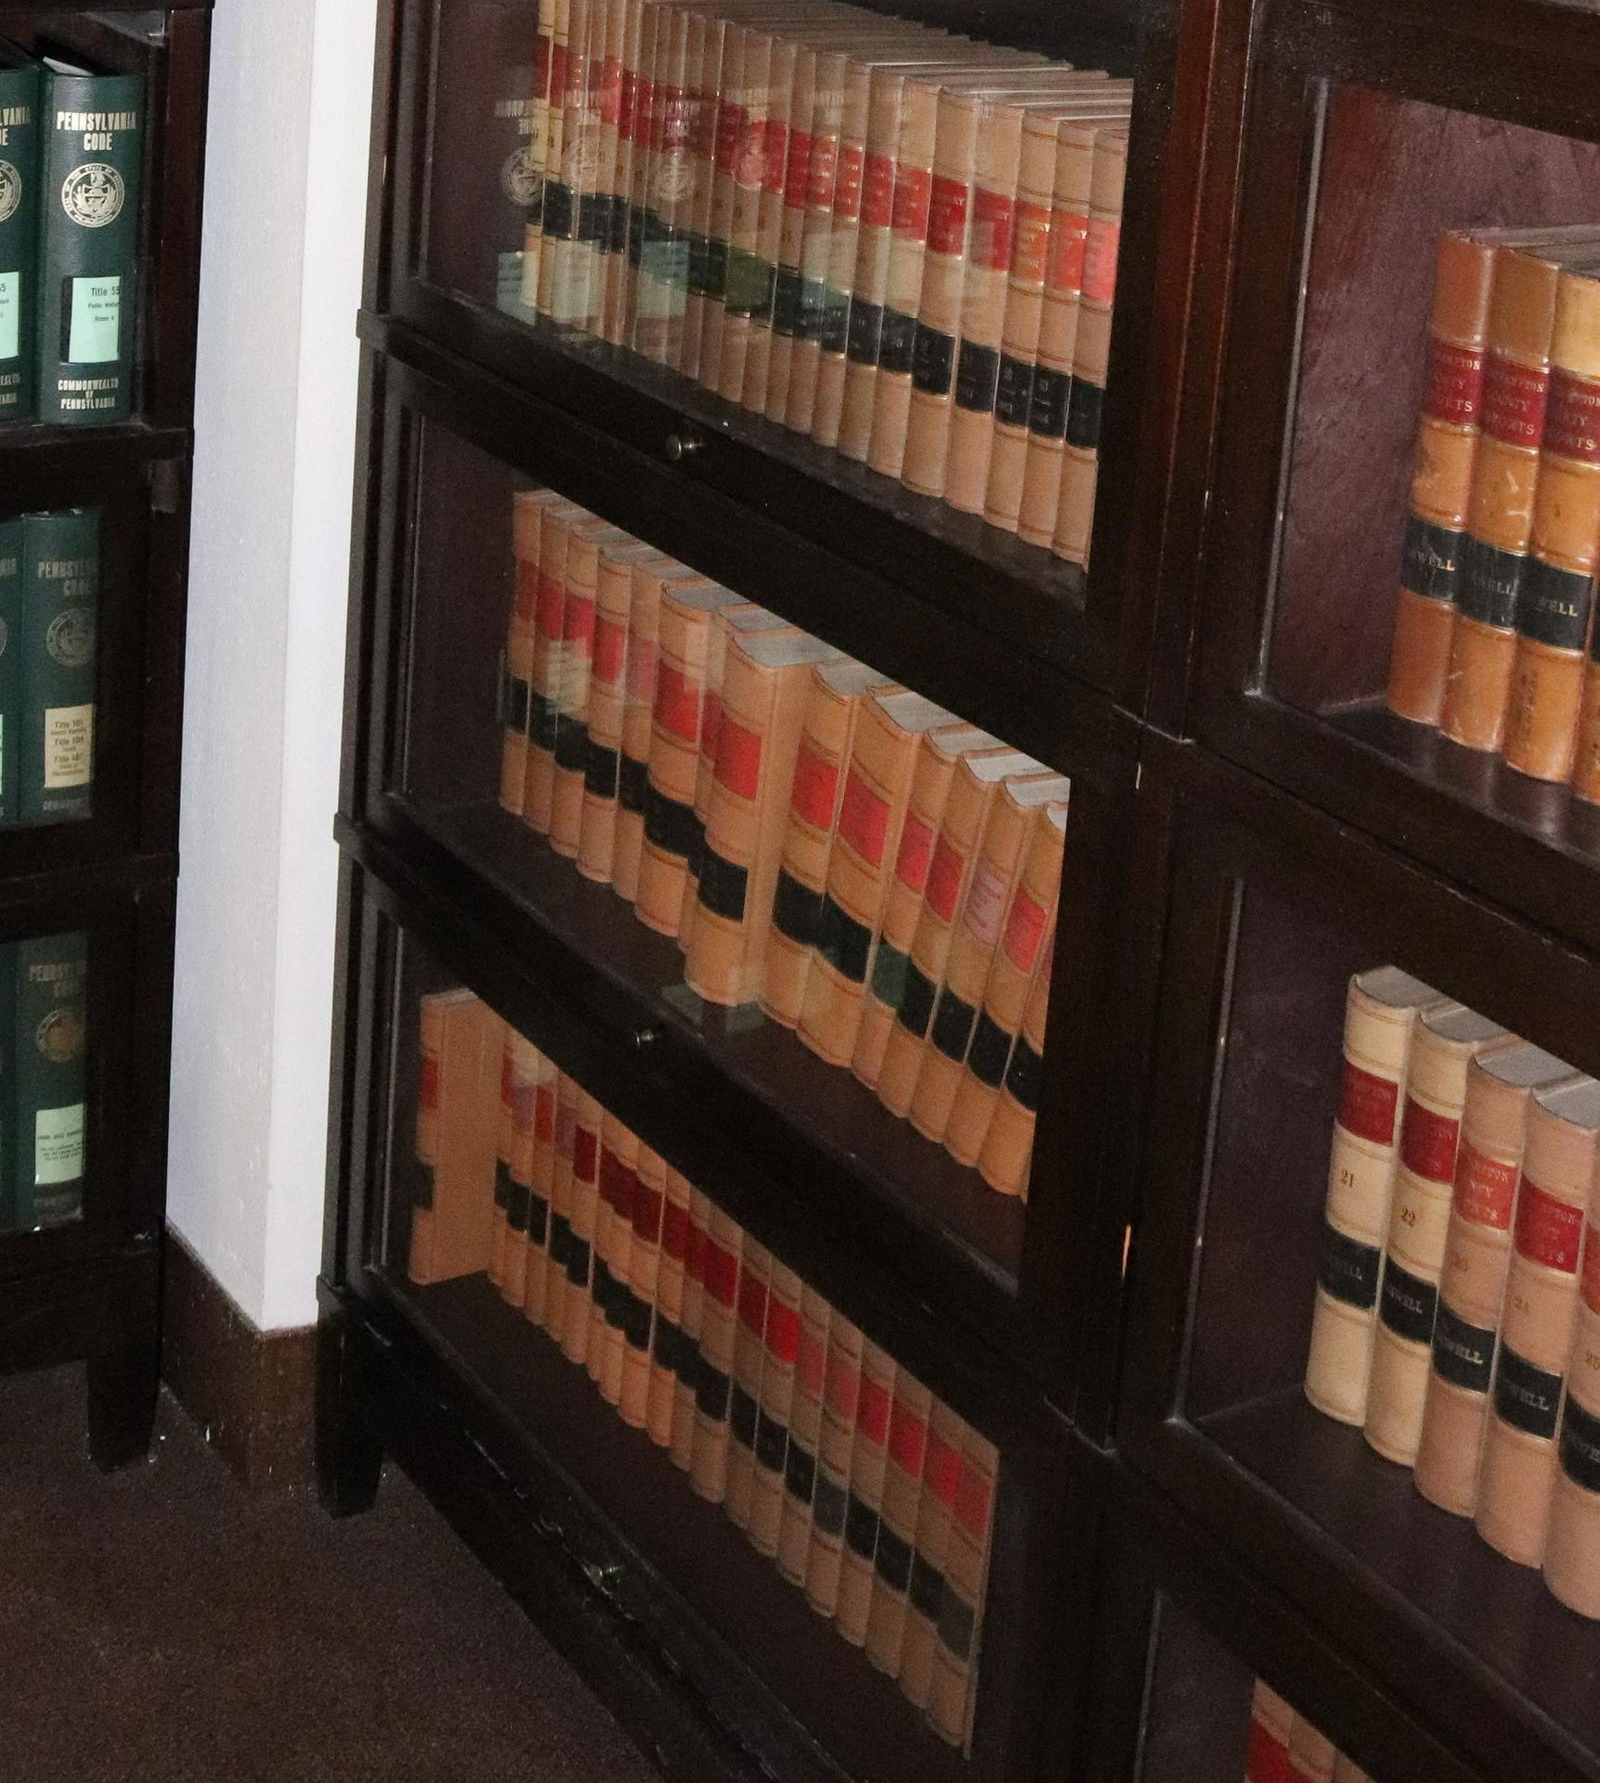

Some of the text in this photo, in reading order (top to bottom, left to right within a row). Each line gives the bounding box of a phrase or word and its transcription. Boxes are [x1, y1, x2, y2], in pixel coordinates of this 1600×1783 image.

[57, 111, 136, 131] PENNSYLVANIA
[83, 133, 112, 151] CODE
[91, 287, 107, 297] Title
[58, 378, 119, 391] COMMONWEALTH
[60, 397, 116, 410] PENNSYLVANIA
[1341, 1168, 1355, 1188] 21
[1401, 1205, 1416, 1227] 22
